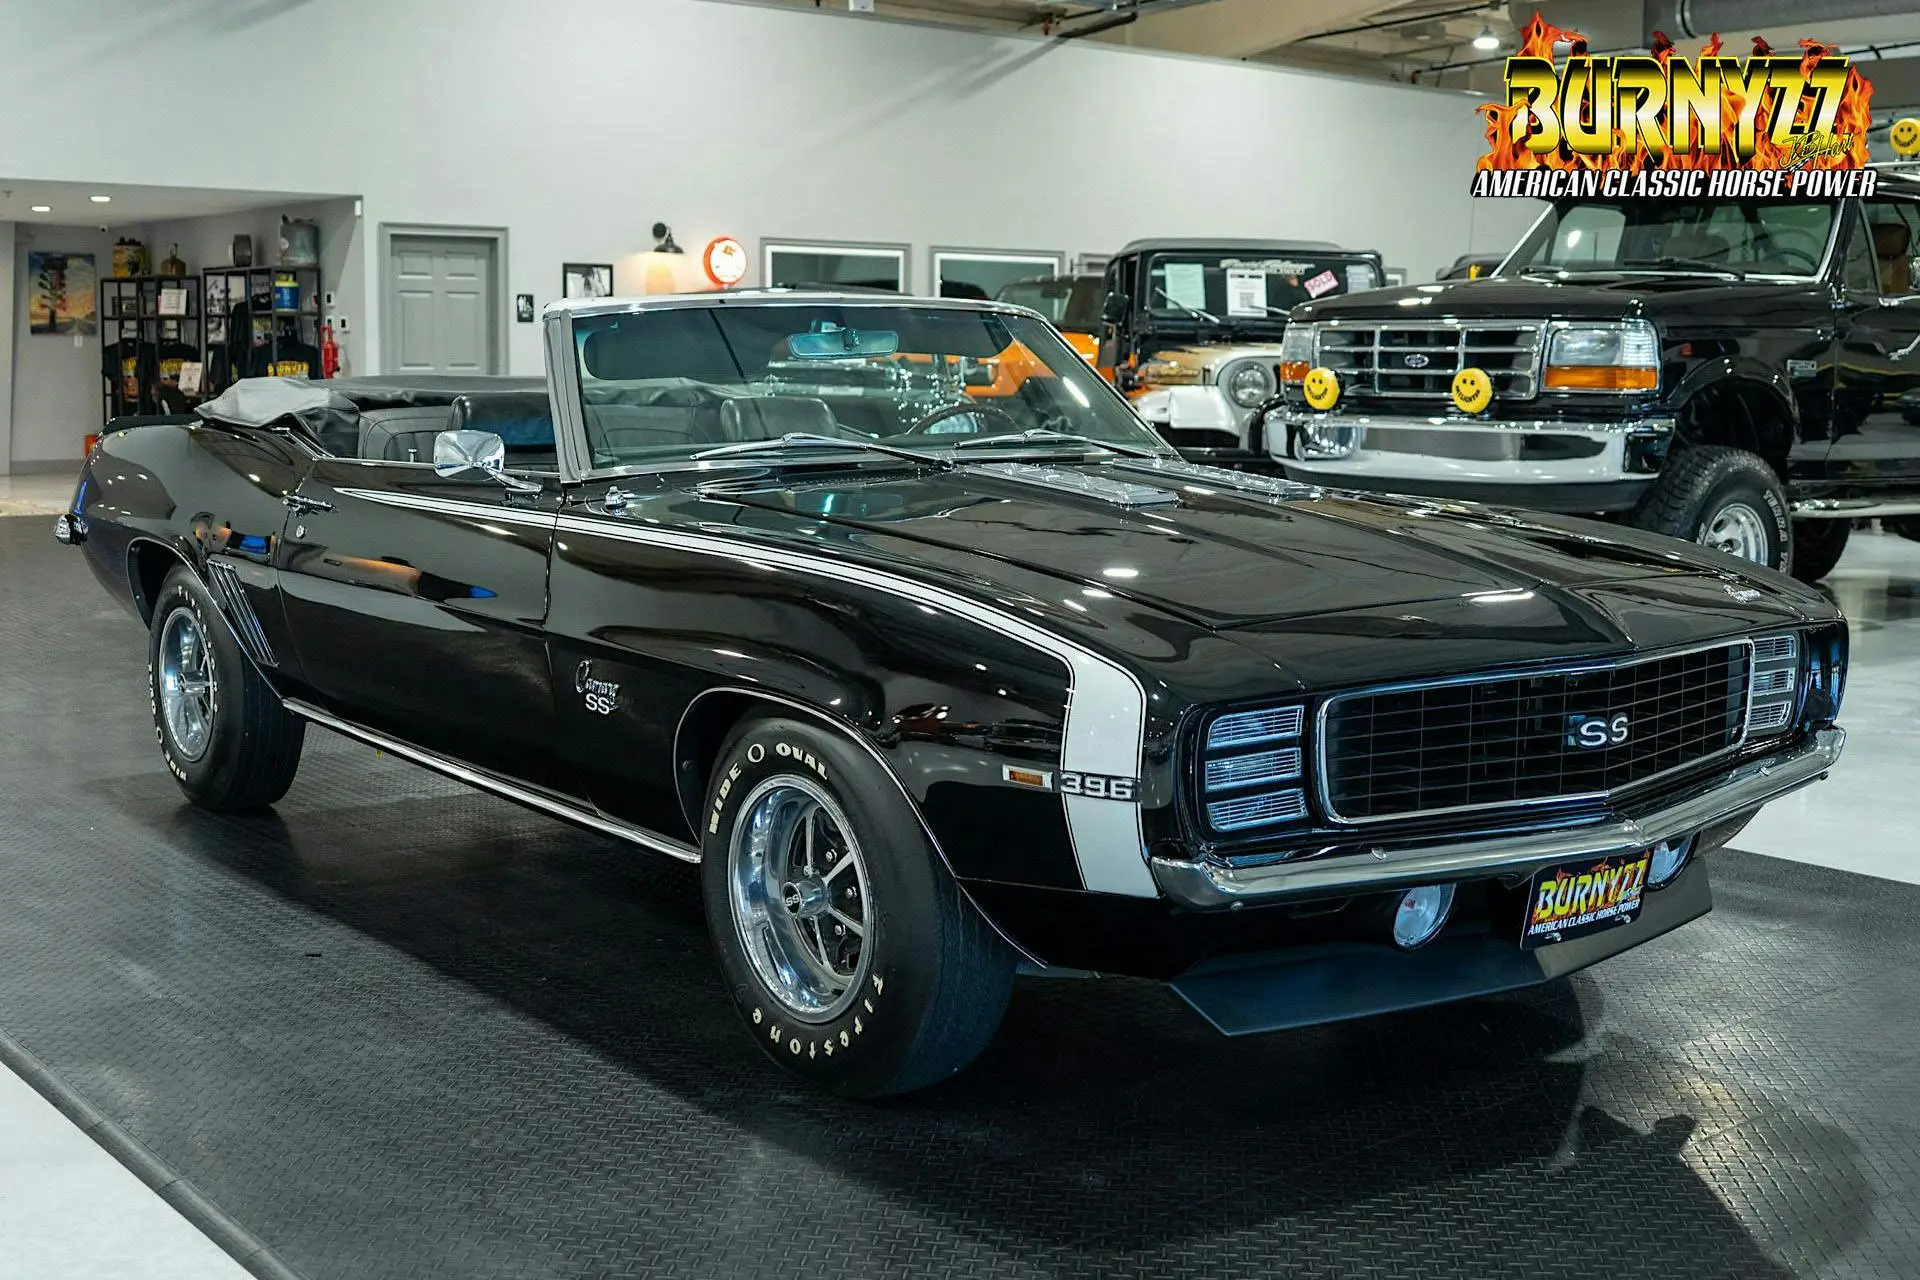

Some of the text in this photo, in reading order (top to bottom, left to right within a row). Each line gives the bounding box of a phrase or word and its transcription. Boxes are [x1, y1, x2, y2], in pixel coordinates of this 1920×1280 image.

[585, 693, 610, 715] SS
[1580, 716, 1628, 747] SS
[708, 762, 742, 834] WIDE
[775, 742, 829, 780] OVAL
[1060, 771, 1133, 800] 396
[785, 894, 800, 906] SS
[1527, 899, 1641, 936] AMERICAN CLASSIC HORSE POWER
